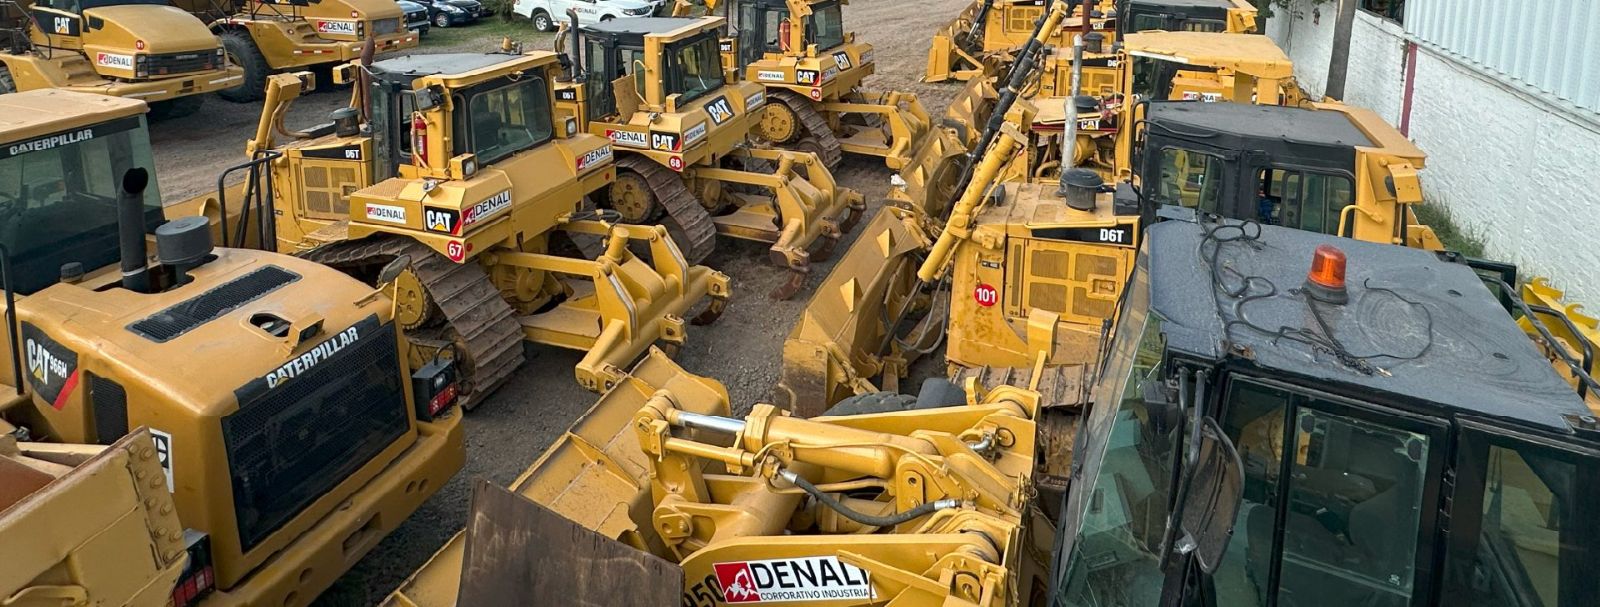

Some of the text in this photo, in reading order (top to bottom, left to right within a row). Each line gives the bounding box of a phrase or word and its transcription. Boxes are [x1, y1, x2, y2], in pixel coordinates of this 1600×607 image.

[54, 17, 70, 34] CAT
[327, 22, 354, 31] DENALI
[109, 56, 132, 66] DENALI
[834, 54, 851, 69] CAT
[797, 71, 815, 83] CAT
[708, 99, 732, 123] CAT
[1081, 120, 1100, 130] CAT
[9, 129, 93, 155] CATERPILLAR
[615, 131, 646, 142] DENALI
[652, 134, 673, 151] CAT
[345, 149, 359, 158] D6T
[670, 159, 680, 167] 68
[475, 190, 511, 216] DENALI
[376, 208, 405, 220] DENALI
[426, 210, 451, 232] CAT
[1100, 229, 1124, 242] D6T
[449, 243, 462, 257] 67
[976, 288, 996, 303] 101
[27, 339, 67, 384] CAT 966H
[266, 326, 359, 388] CATERPILLAR
[750, 558, 868, 589] DENALI
[760, 590, 821, 600] CORPORATIVO
